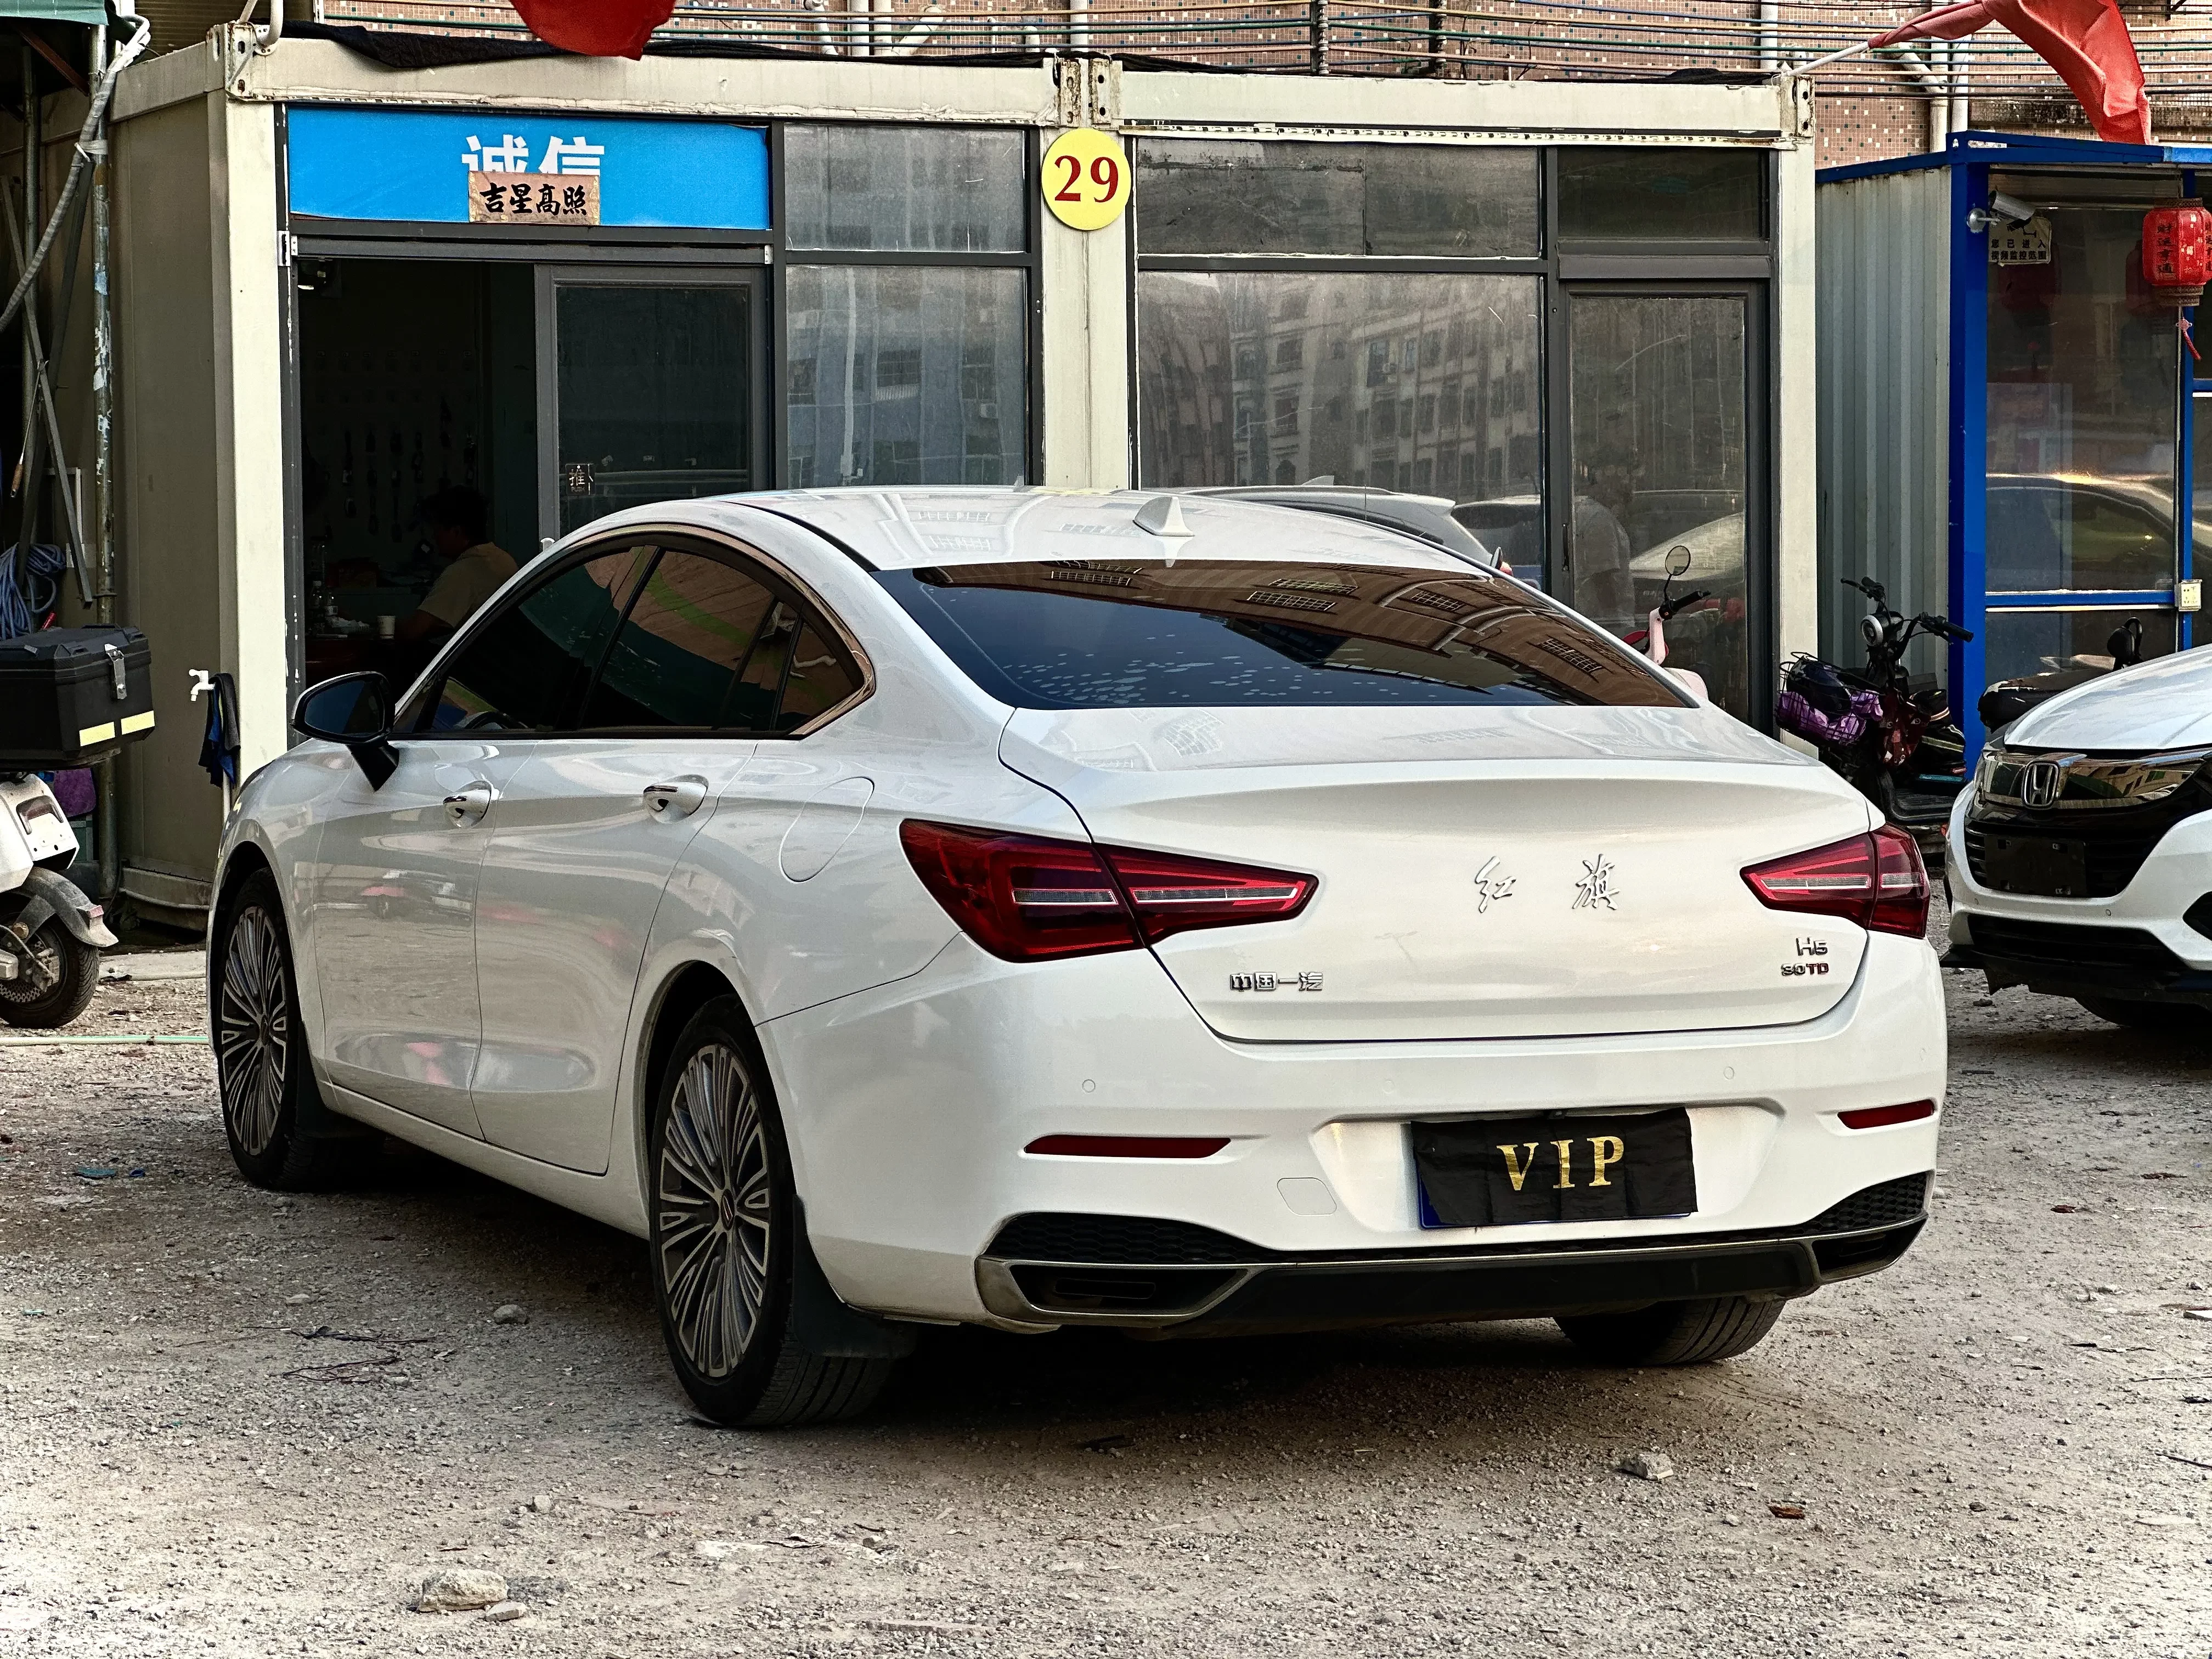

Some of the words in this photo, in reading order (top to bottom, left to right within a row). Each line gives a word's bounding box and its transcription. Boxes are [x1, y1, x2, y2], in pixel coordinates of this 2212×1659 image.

[461, 134, 605, 175] 诚信
[1054, 155, 1119, 203] 29
[480, 182, 587, 216] 吉星高照
[1991, 239, 2046, 249] 您已进入
[1991, 250, 2047, 261] 视频监控范围
[569, 469, 585, 486] 推
[1475, 853, 1621, 913] 红旗
[1796, 937, 1828, 956] H5
[1230, 972, 1323, 992] 中国一汽
[1496, 1136, 1624, 1191] VIP
